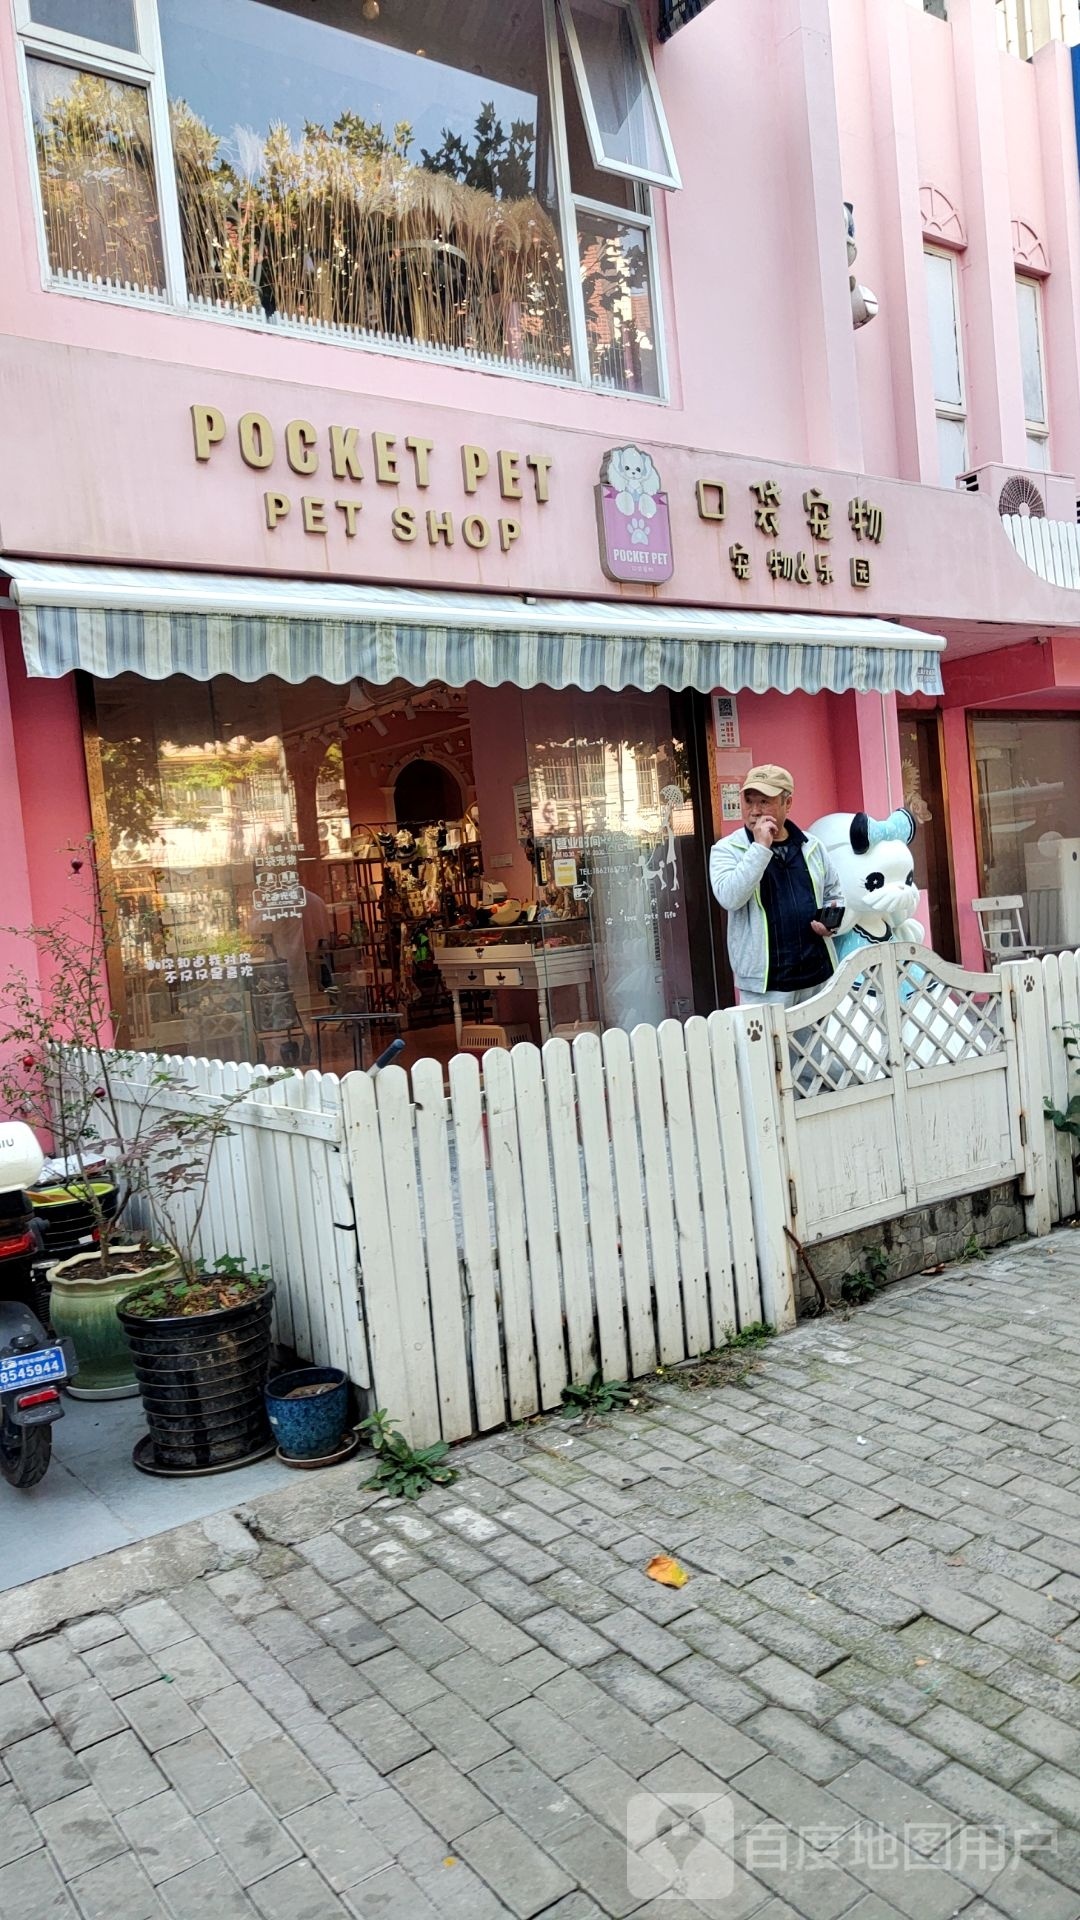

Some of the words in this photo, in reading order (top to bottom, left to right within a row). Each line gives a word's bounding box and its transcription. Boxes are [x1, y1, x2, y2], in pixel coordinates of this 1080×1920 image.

[190, 404, 434, 488] POCKET
[461, 444, 552, 503] PET
[264, 491, 363, 537] PET
[392, 506, 521, 551] SHOP
[696, 479, 884, 544] 口袋宠物
[613, 548, 650, 564] POCKET
[651, 552, 668, 565] PET
[165, 965, 253, 983] 不仅仅是喜欢
[0, 1137, 15, 1149] IU
[0, 1360, 60, 1383] 8545944
